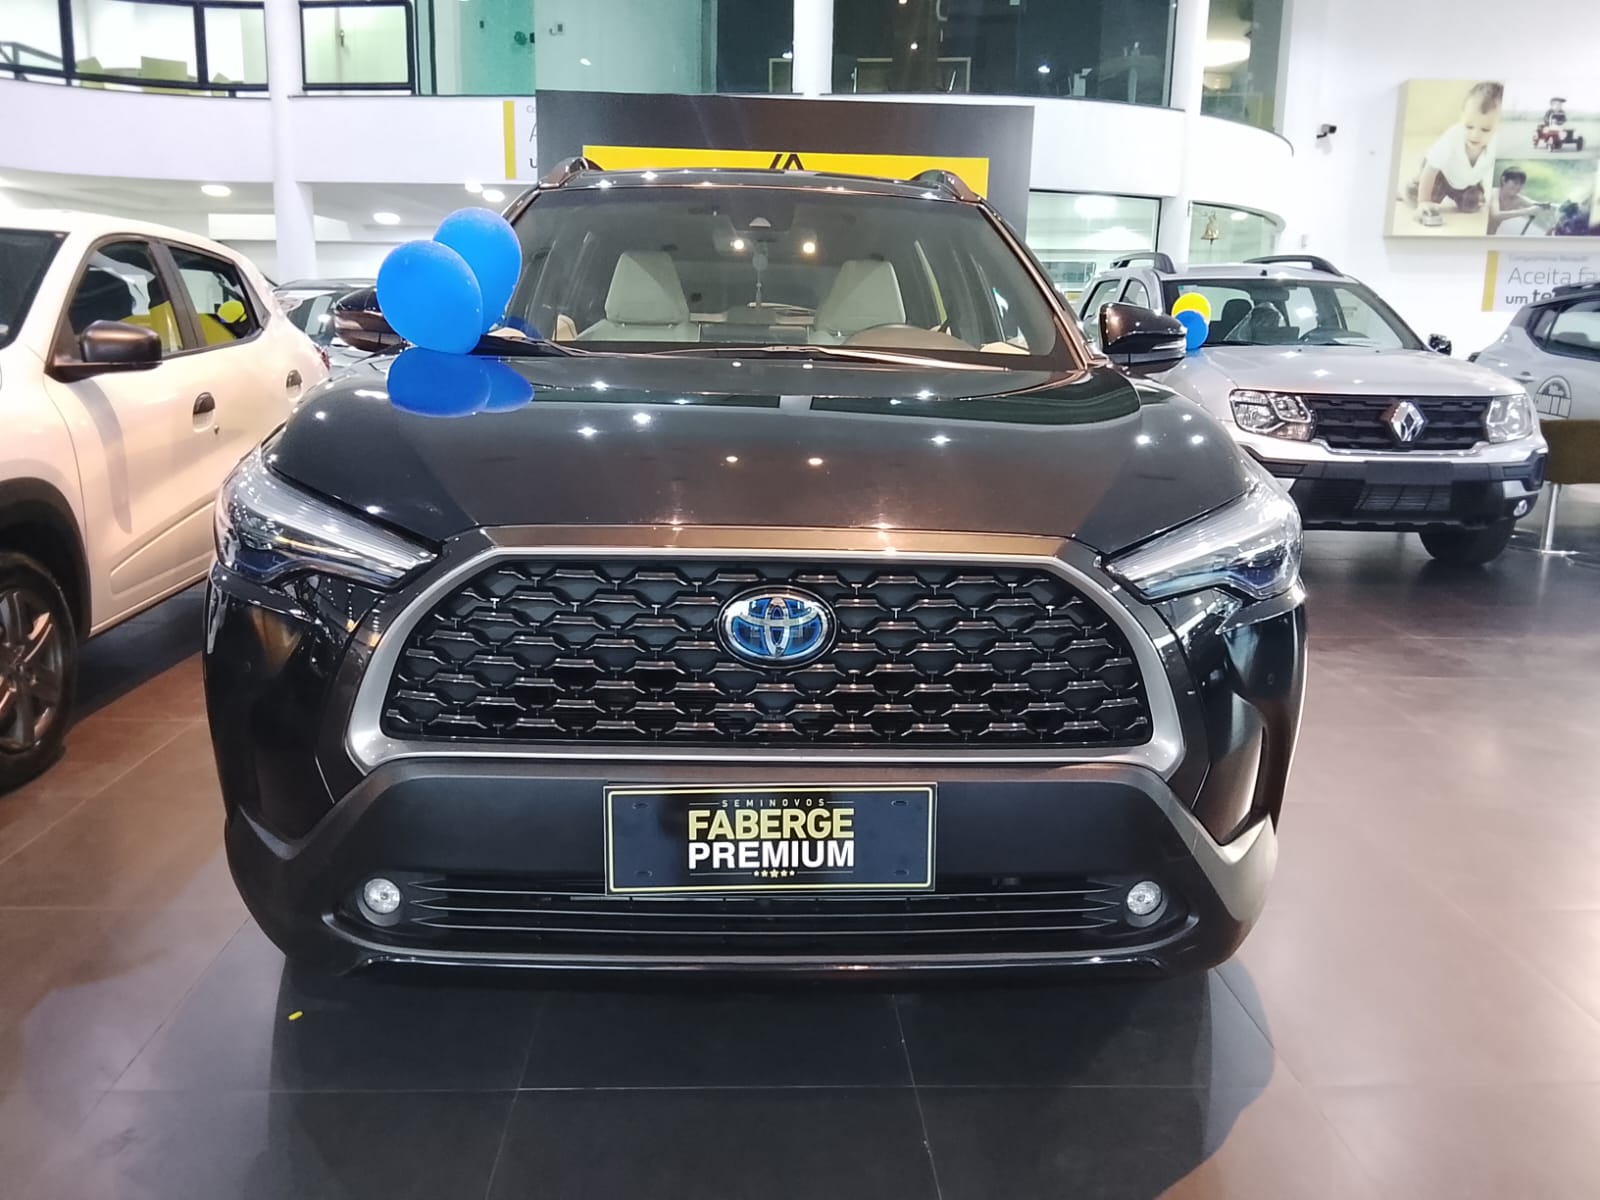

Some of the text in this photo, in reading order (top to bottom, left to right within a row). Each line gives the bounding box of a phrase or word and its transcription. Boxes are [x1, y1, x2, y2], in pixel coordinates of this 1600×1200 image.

[1507, 266, 1572, 285] Aceita
[1505, 295, 1529, 304] um
[721, 798, 825, 808] SEMINOVOS
[688, 808, 855, 841] FABERGE
[688, 840, 855, 869] PREMIUM
